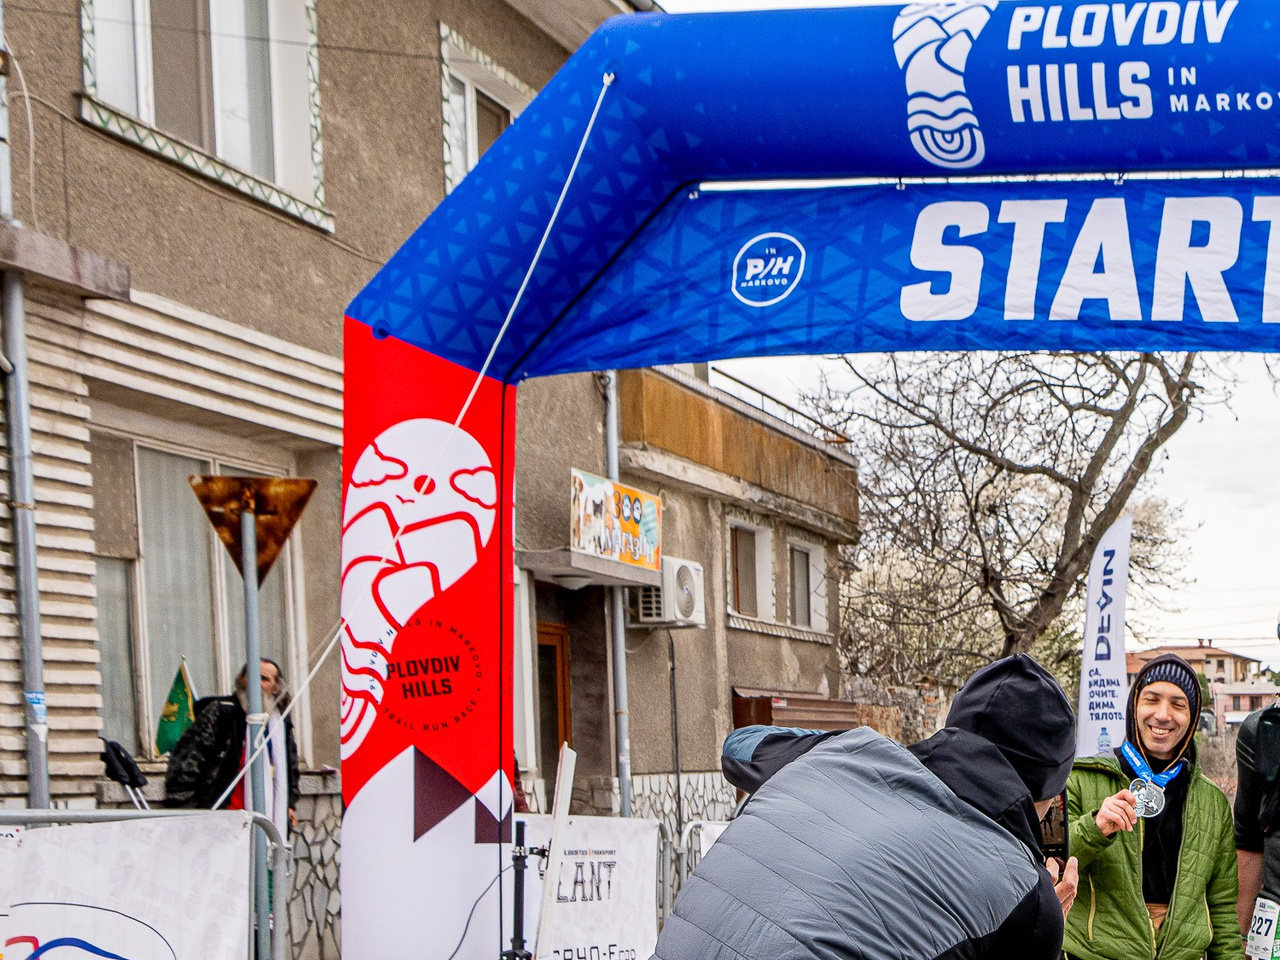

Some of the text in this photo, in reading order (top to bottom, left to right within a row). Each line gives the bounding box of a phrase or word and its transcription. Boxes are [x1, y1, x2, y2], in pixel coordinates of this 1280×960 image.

[1008, 0, 1239, 50] PLOVDIV
[1168, 66, 1197, 86] IN
[1007, 61, 1154, 123] HILLS
[765, 247, 777, 255] IN
[745, 255, 795, 281] P/H
[740, 277, 788, 288] MARKOVO
[430, 619, 443, 628] IN
[386, 655, 460, 680] PLOVDIV
[401, 678, 453, 699] HILLS
[382, 700, 477, 731] TRAIL RUN RACE
[1090, 712, 1125, 721] ТЯЛОТО.
